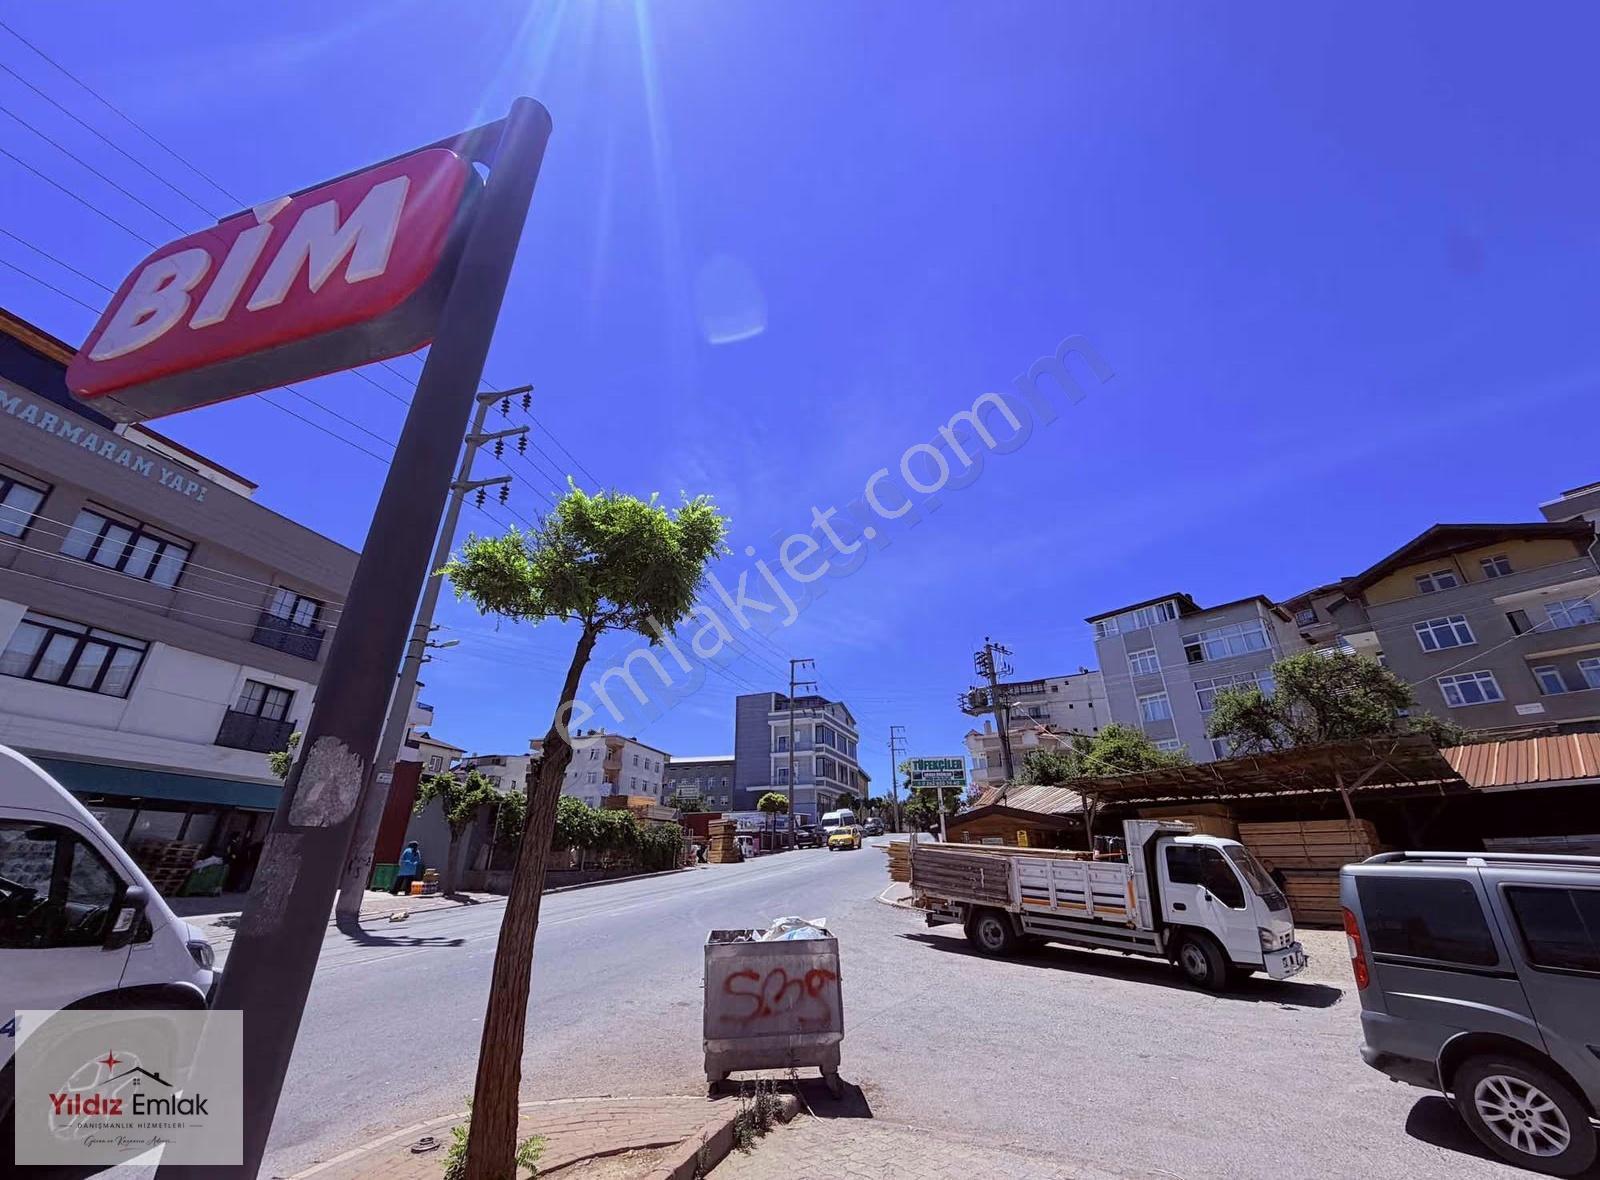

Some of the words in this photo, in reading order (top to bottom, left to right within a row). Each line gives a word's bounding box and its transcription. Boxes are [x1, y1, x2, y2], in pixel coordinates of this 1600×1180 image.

[89, 176, 410, 361] BİM
[0, 390, 154, 476] MARMARAM
[159, 467, 208, 502] YAPI
